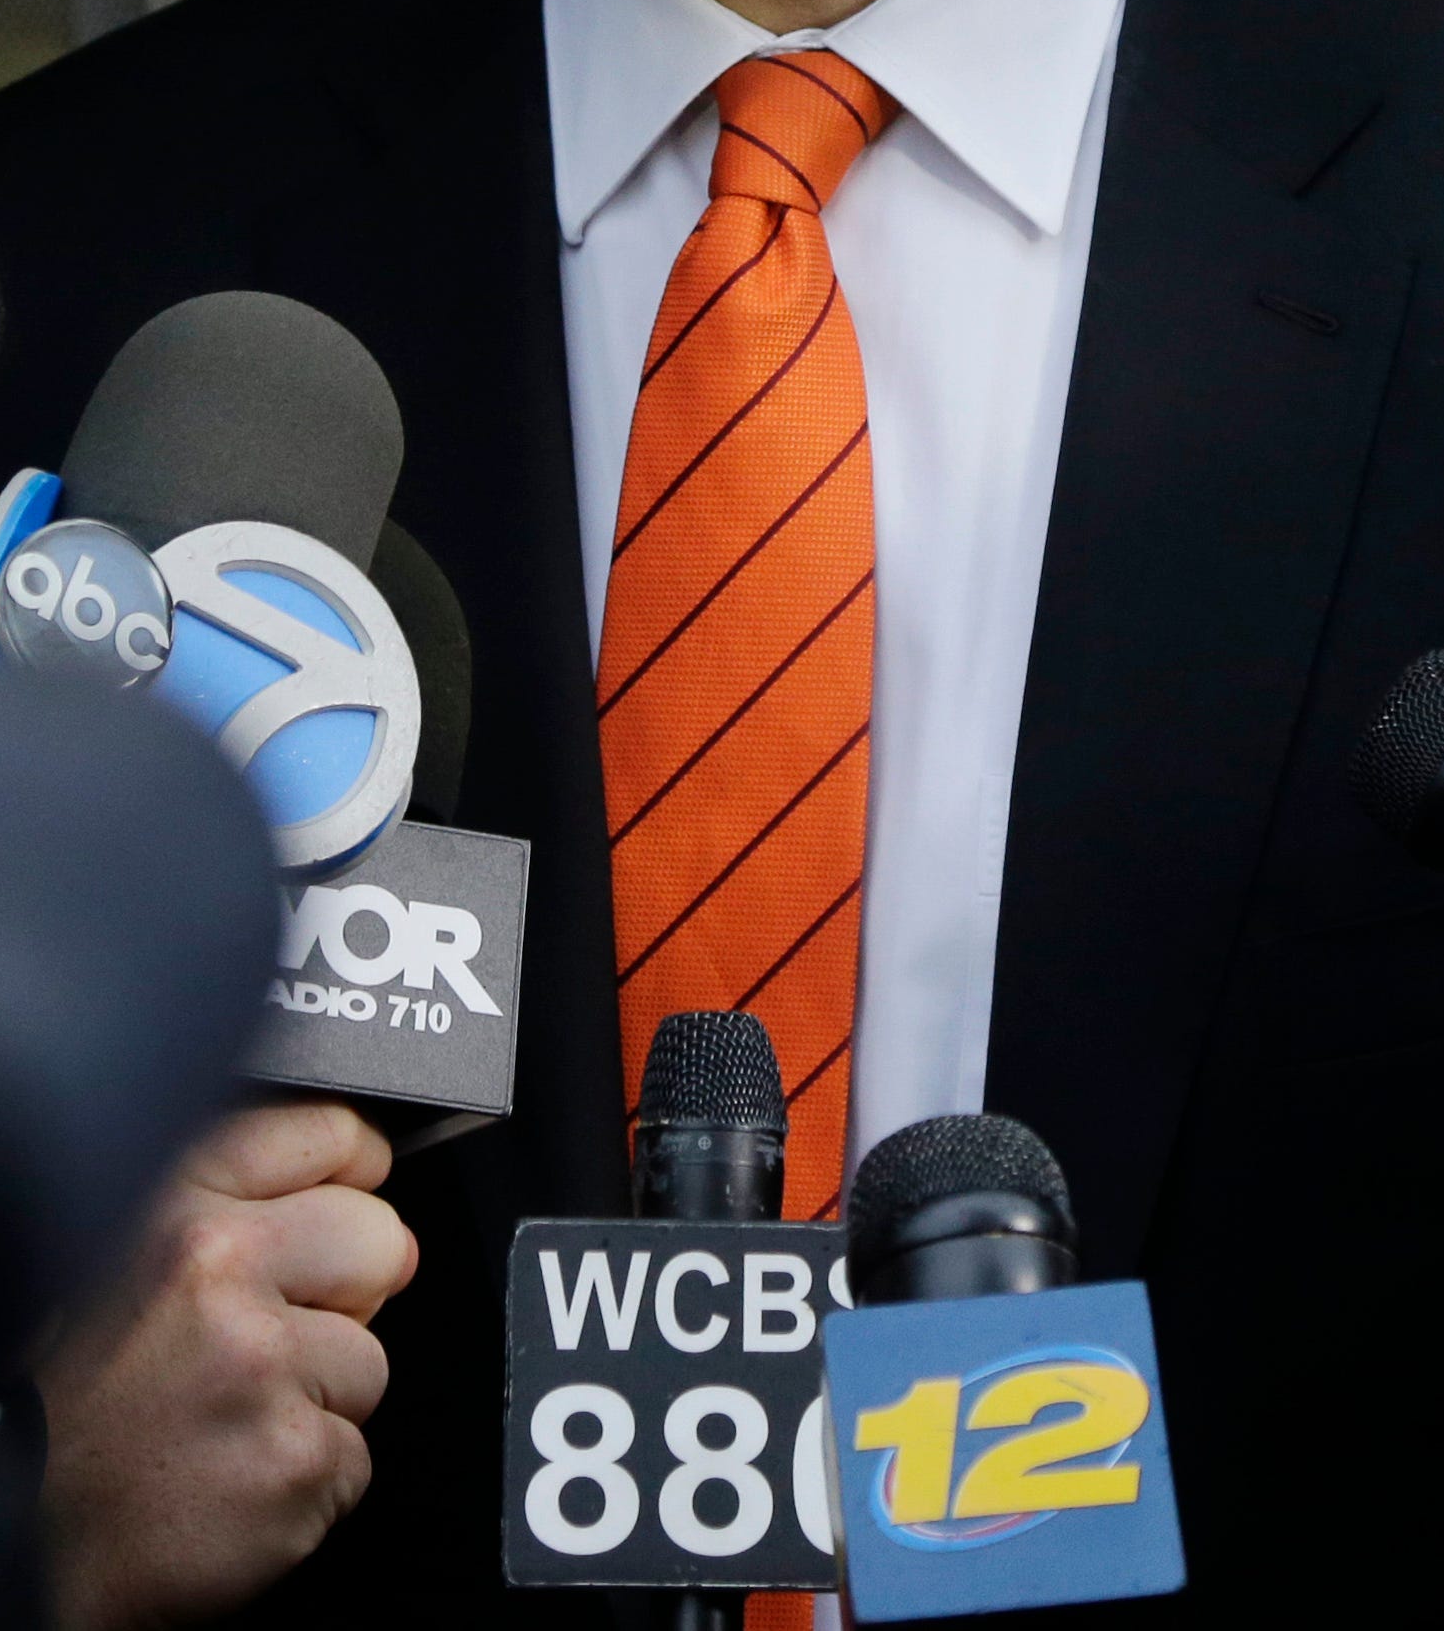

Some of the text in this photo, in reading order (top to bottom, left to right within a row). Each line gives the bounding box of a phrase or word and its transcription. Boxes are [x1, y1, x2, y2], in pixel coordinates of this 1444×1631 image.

[5, 554, 170, 671] abc
[266, 978, 453, 1035] ADIO 710
[538, 1250, 854, 1354] WCB
[854, 1361, 1150, 1526] 12
